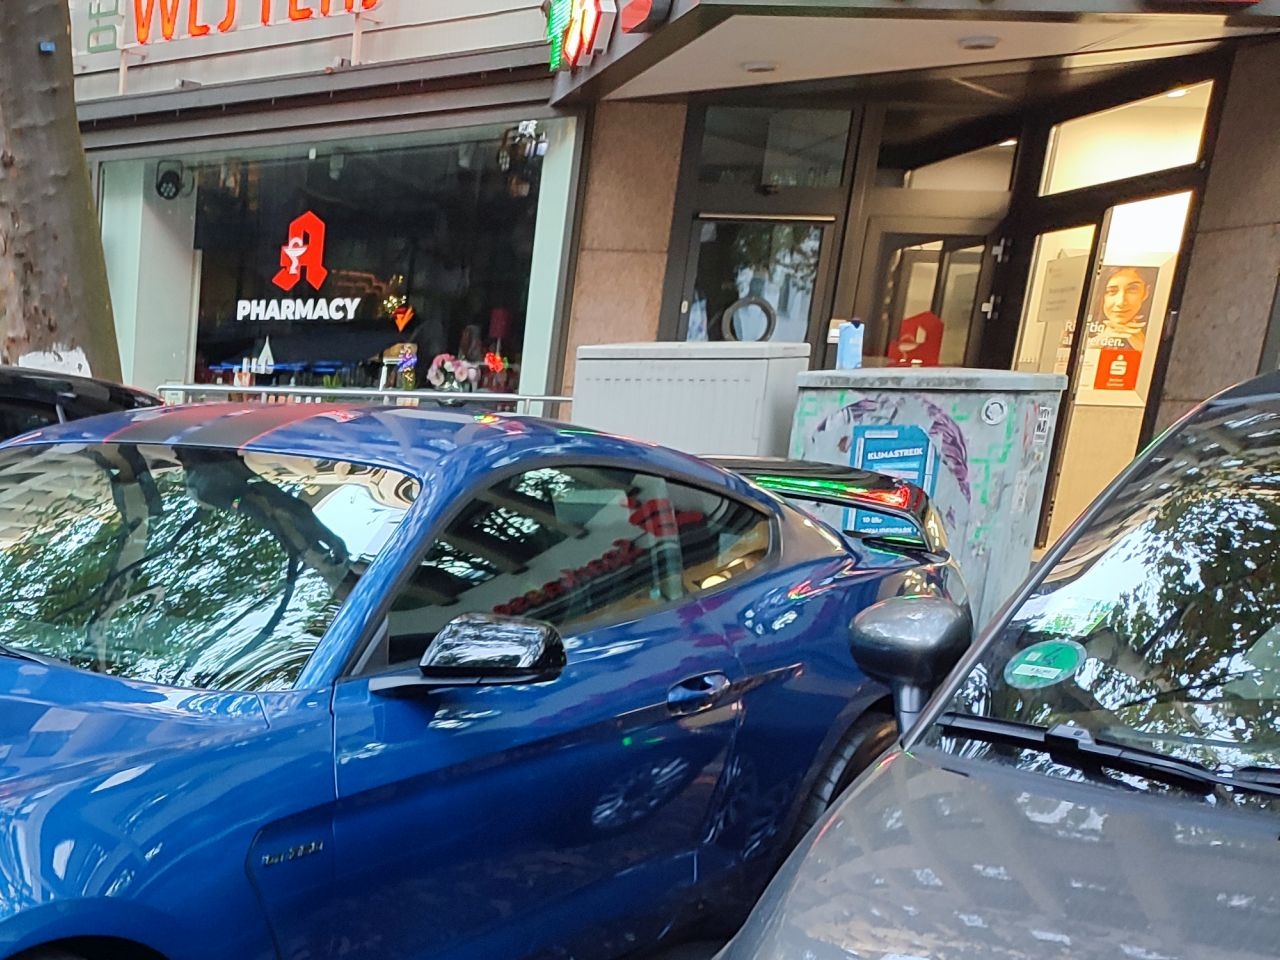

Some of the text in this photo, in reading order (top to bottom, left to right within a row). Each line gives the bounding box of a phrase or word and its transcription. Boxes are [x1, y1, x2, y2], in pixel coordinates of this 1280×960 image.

[237, 298, 361, 320] PHARMACY
[1065, 320, 1105, 333] Ritig
[867, 448, 923, 460] KLIMASTREIK
